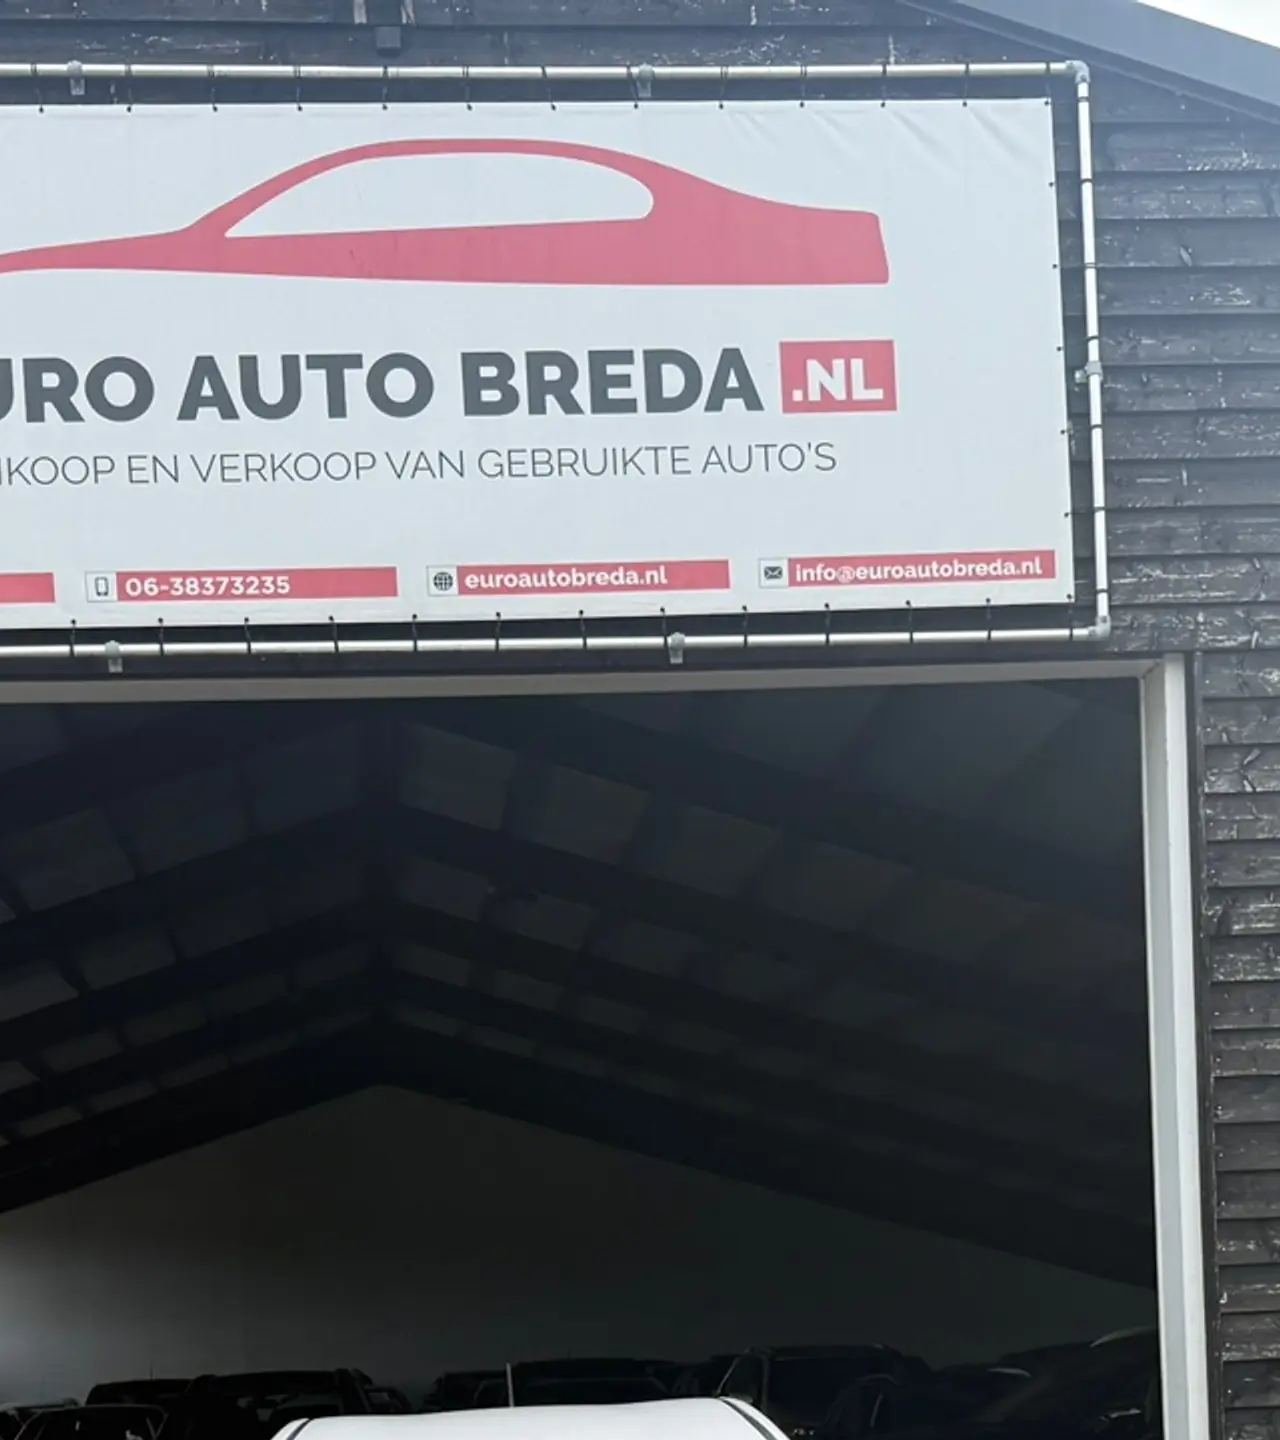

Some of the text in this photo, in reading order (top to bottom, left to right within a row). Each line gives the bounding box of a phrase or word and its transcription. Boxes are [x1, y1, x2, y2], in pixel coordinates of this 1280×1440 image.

[176, 352, 435, 421] AUTO
[460, 347, 765, 417] BREDA
[791, 357, 884, 403] .NL
[127, 453, 180, 484] EN
[189, 451, 376, 484] VERKOOP
[384, 449, 466, 480] VAN
[476, 445, 692, 478] GEBRUIKTE
[701, 442, 838, 475] AUTO'S
[464, 564, 669, 589] euroautobreda.nl
[795, 555, 1043, 584] info@euroautobreda.nl
[124, 575, 292, 597] 06-38373235
